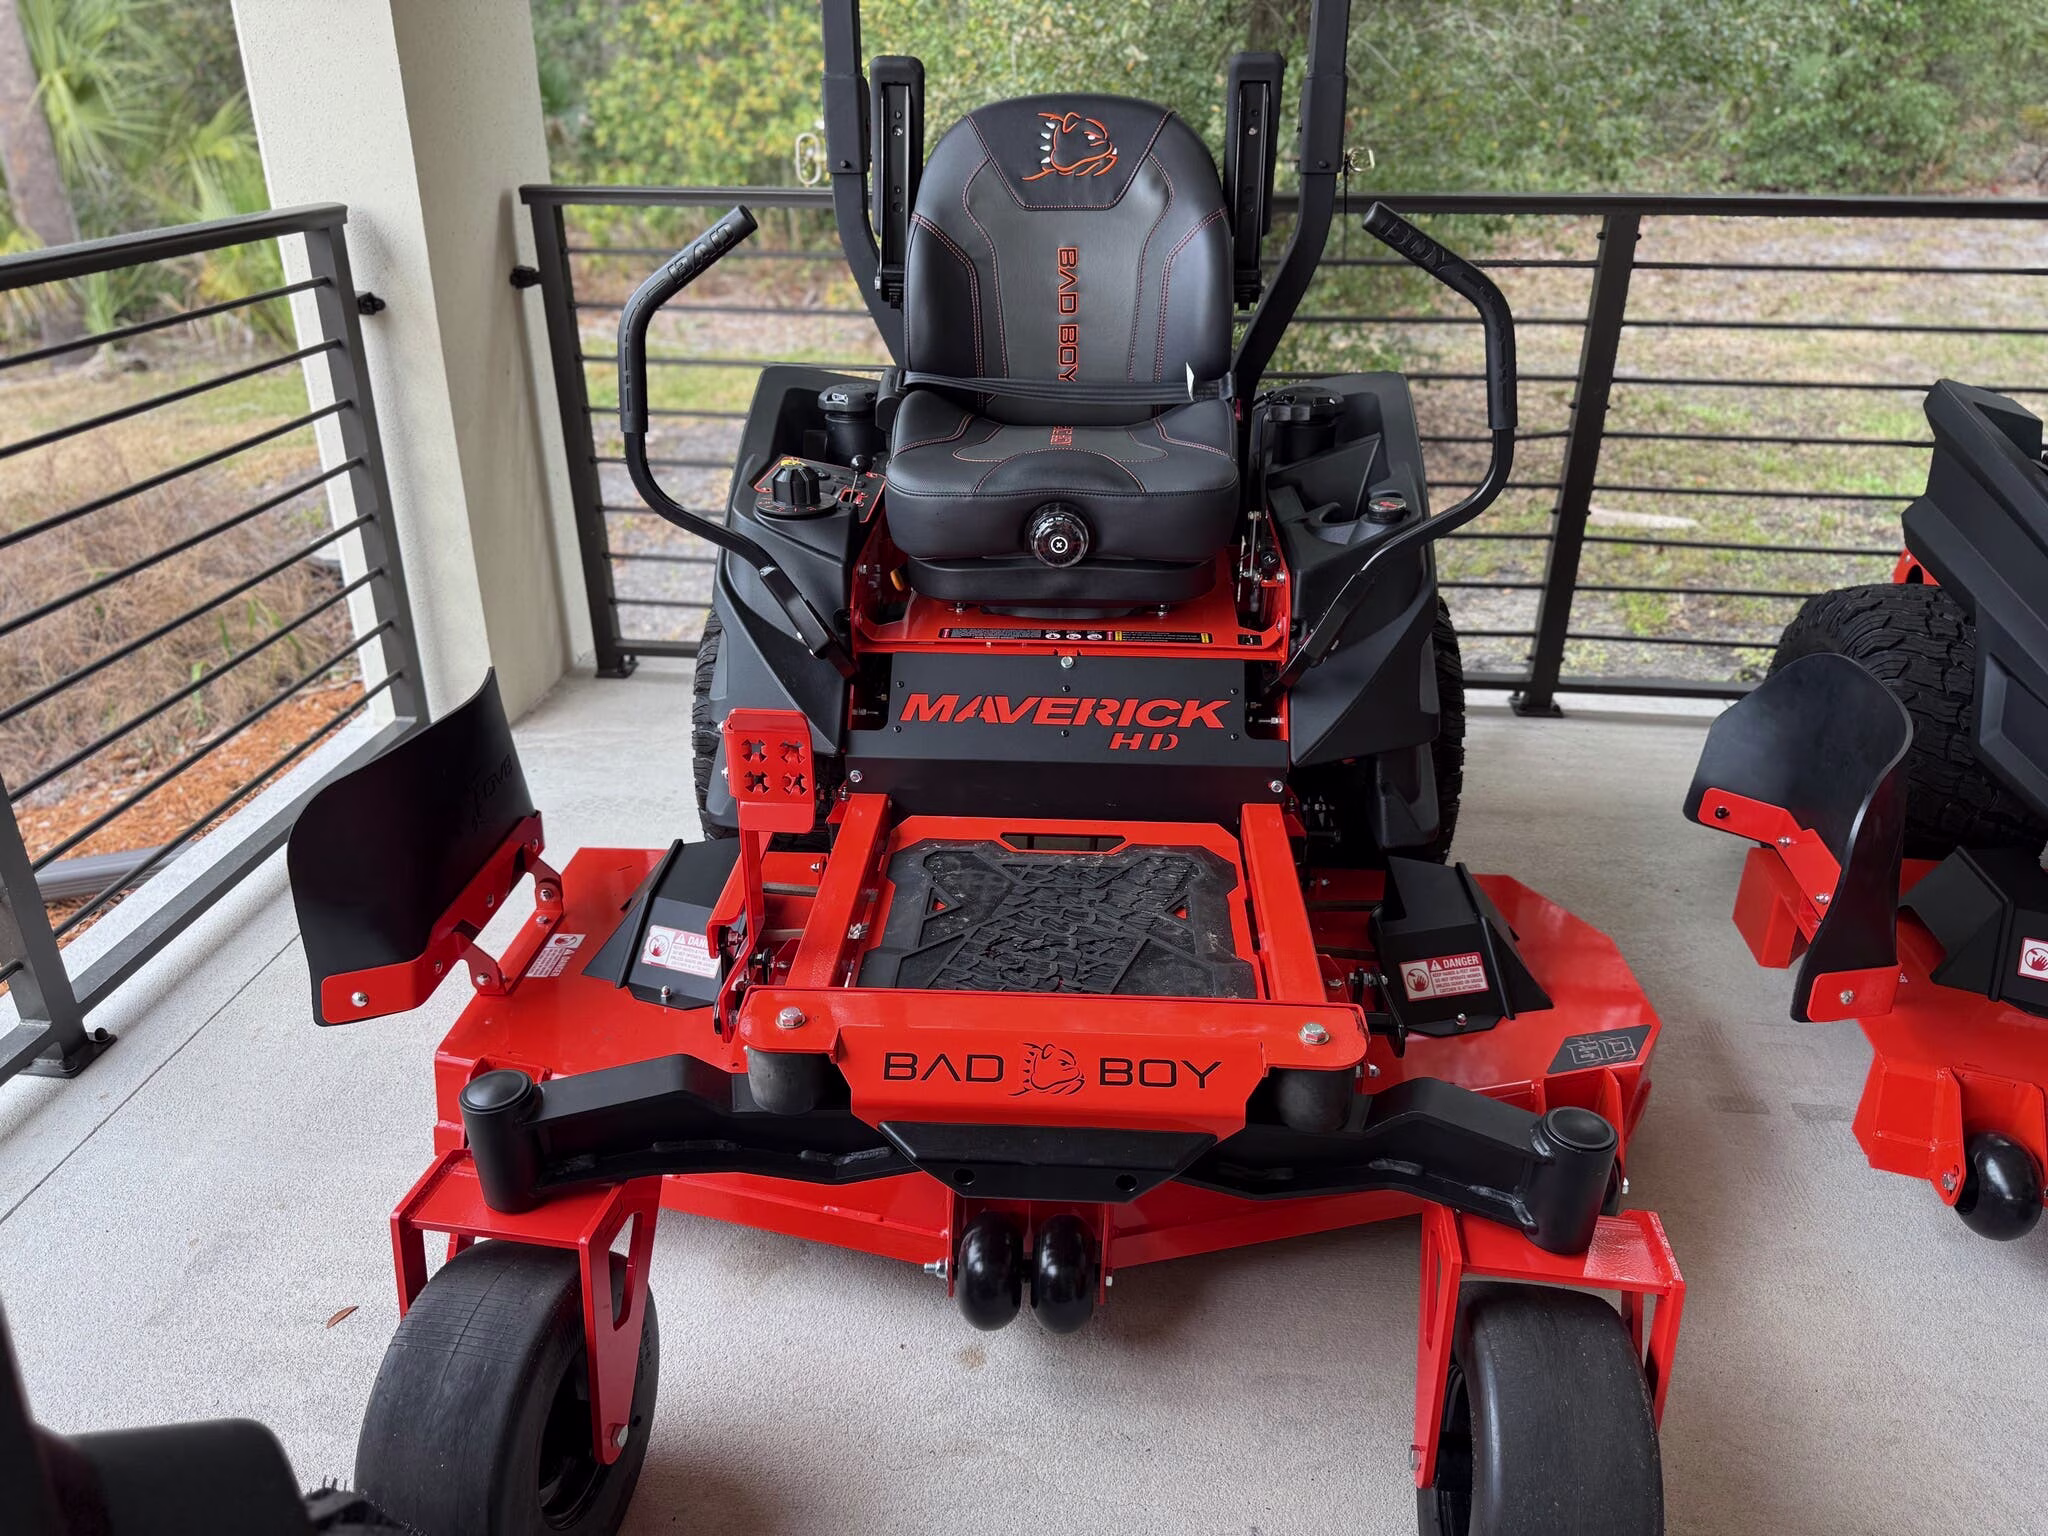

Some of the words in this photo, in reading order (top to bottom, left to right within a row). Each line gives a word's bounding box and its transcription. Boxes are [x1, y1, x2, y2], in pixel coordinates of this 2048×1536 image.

[667, 223, 734, 284] BAD
[1057, 247, 1079, 316] BAD
[1058, 324, 1079, 382] BOY
[900, 693, 1231, 729] MAVERICK
[1109, 732, 1179, 751] HD
[1442, 955, 1479, 969] DANGER
[883, 1052, 1004, 1083] BAD
[1099, 1057, 1223, 1089] BOY
